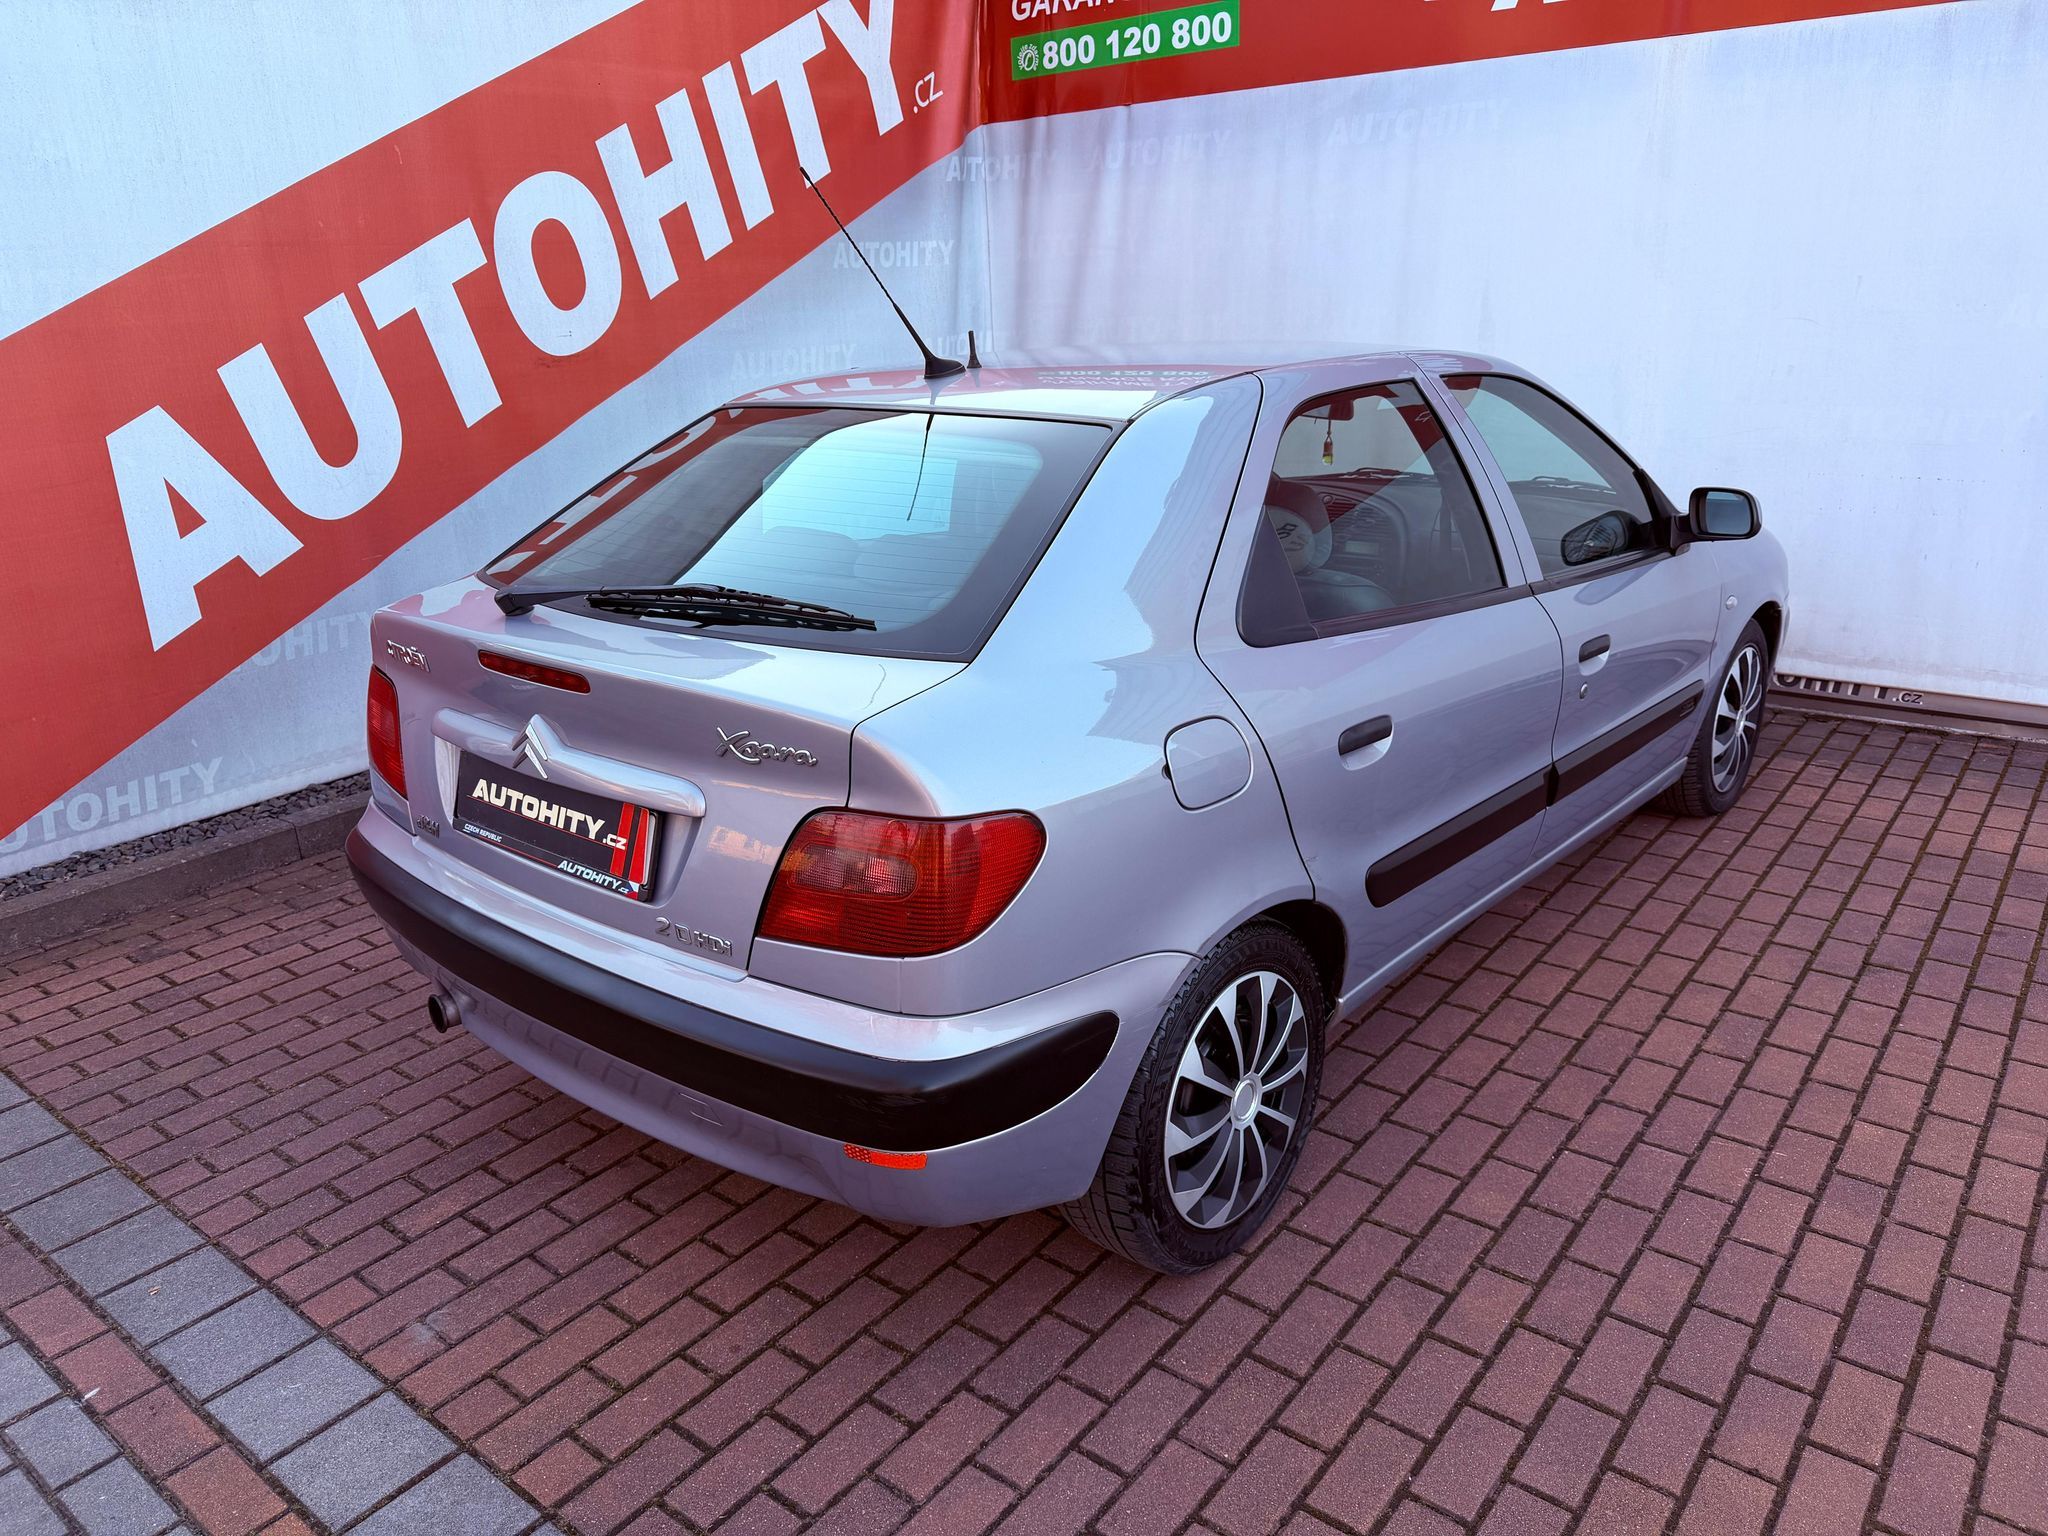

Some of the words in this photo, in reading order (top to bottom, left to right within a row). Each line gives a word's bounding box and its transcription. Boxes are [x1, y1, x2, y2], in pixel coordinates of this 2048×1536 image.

[1042, 34, 1096, 70] 800
[1105, 23, 1162, 60] 120
[1171, 11, 1233, 50] 800
